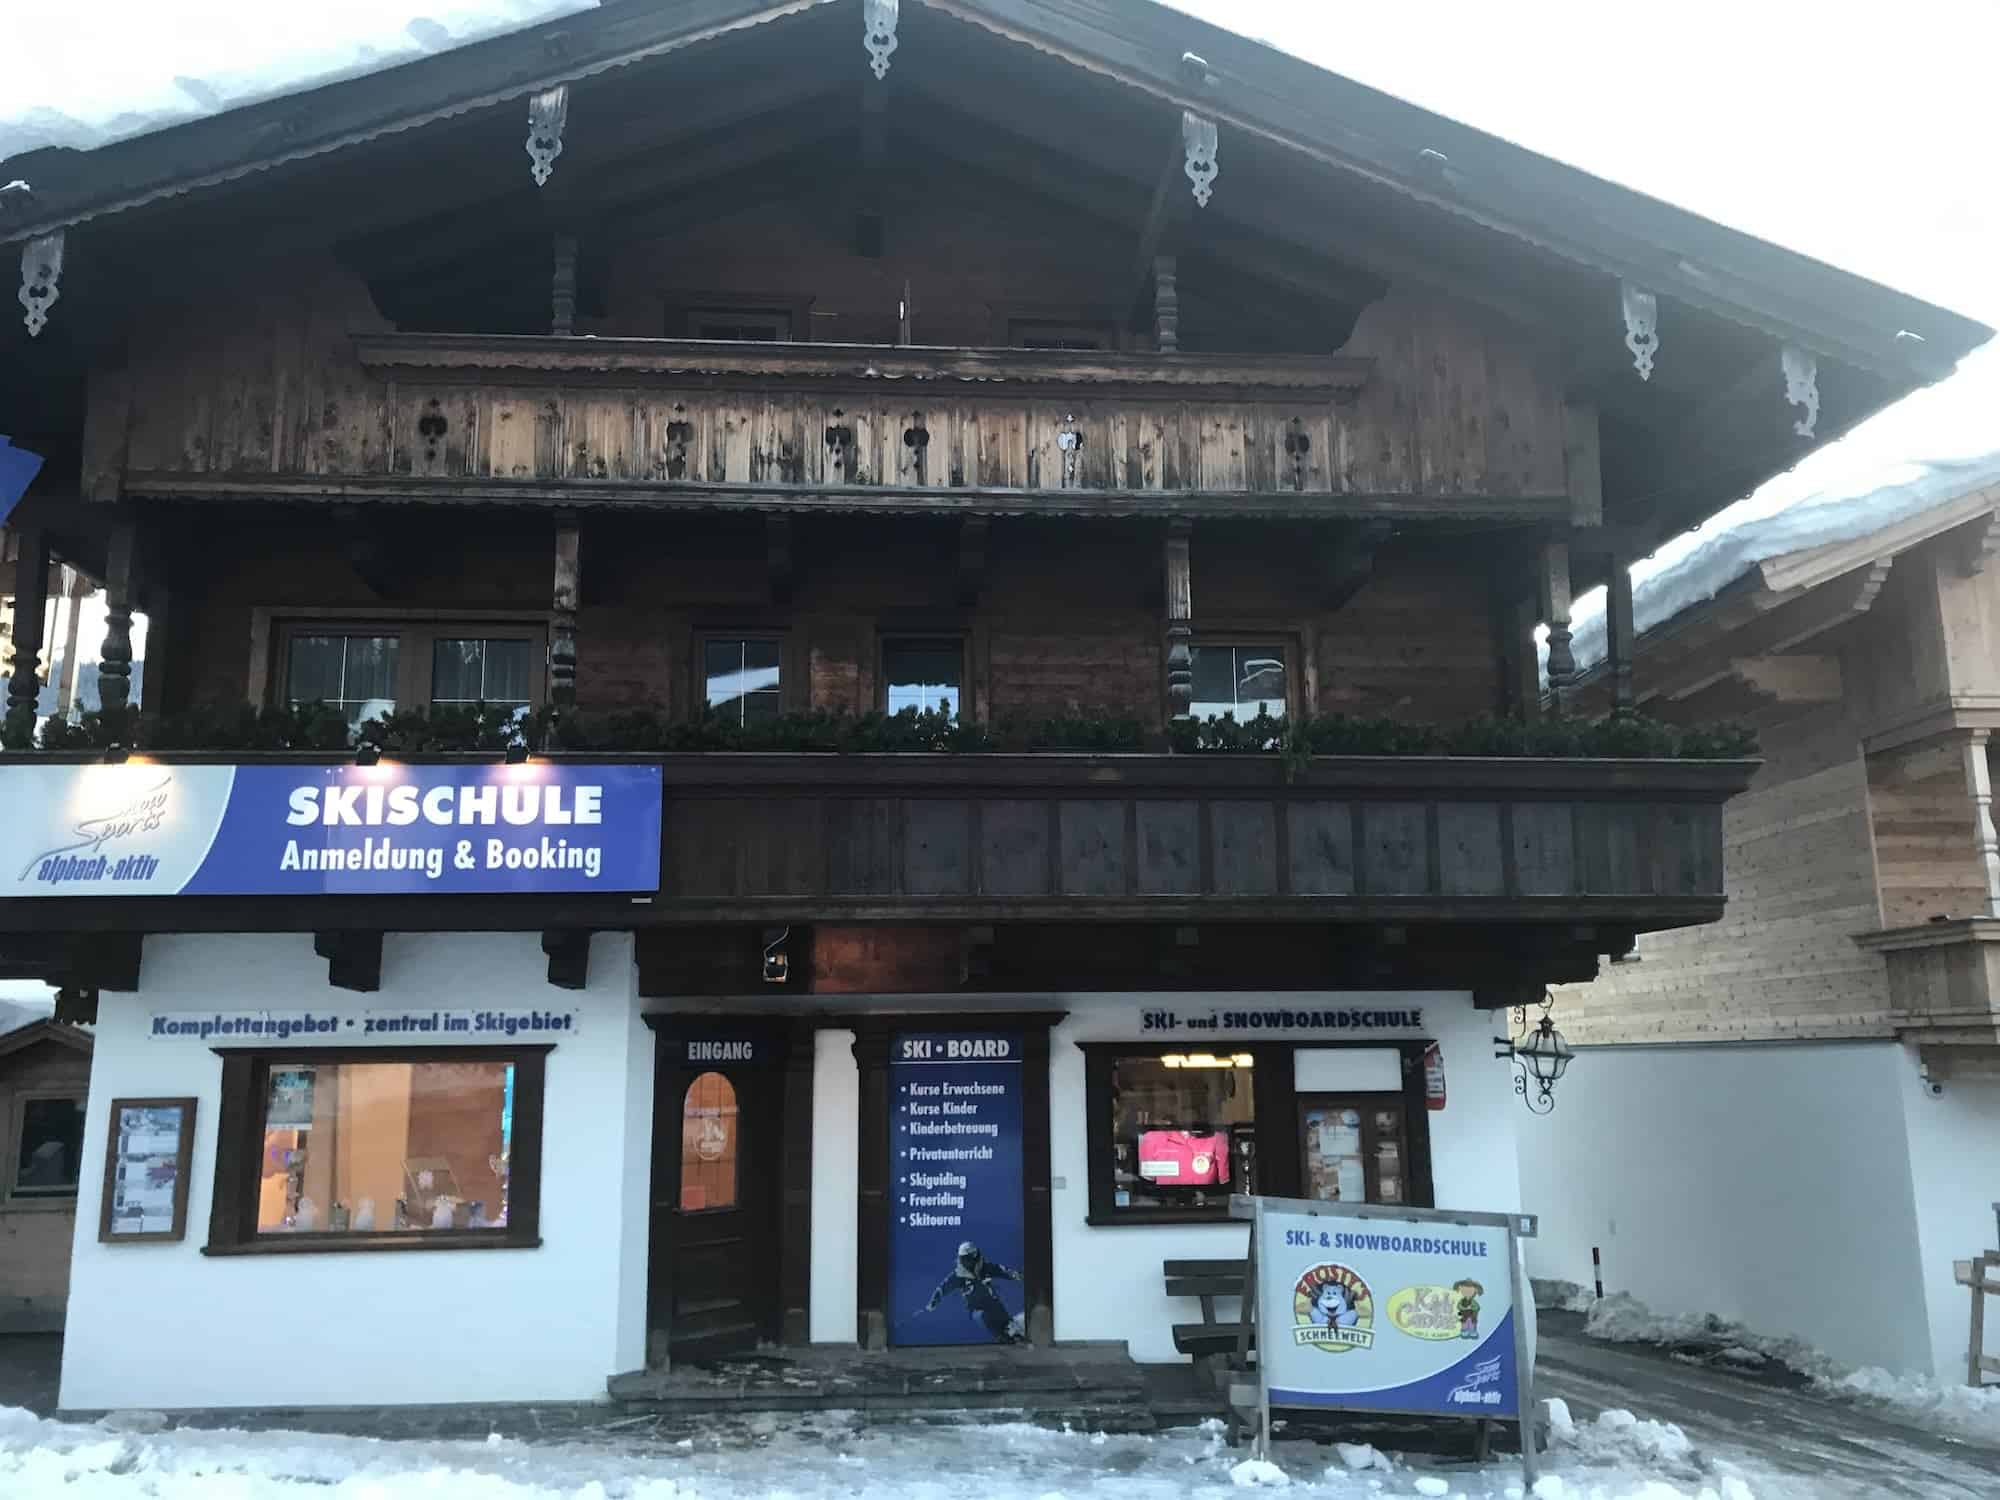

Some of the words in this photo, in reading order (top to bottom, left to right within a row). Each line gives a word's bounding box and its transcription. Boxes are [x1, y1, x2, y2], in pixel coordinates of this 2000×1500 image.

[286, 785, 603, 826] SKISCHULE
[280, 838, 443, 879] Anmeldung
[454, 839, 475, 870] &
[486, 837, 601, 878] Booking
[152, 1013, 338, 1040] Komplettangebot
[364, 1012, 439, 1032] zentral
[444, 1013, 469, 1031] im
[474, 1011, 572, 1036] Skigebiet
[1143, 1013, 1182, 1029] SKI-
[1187, 1014, 1218, 1029] und
[1224, 1010, 1421, 1029] SNOWBOARDSCHULE
[688, 1041, 753, 1060] EINGANG
[903, 1040, 931, 1058] SKI
[947, 1039, 1010, 1058] BOARD
[910, 1082, 940, 1096] Kurse
[943, 1081, 1005, 1095] Erwachsene
[910, 1101, 940, 1115] Kurse
[943, 1100, 978, 1114] Kinder
[910, 1120, 998, 1137] Kinderbetreuung
[910, 1145, 993, 1160] Privatunterricht
[910, 1171, 967, 1189] Skiguiding
[910, 1192, 964, 1208] Freeriding
[910, 1212, 961, 1226] Skitouren
[1286, 1230, 1315, 1246] SKI-
[1319, 1231, 1331, 1248] &
[1335, 1232, 1488, 1257] SNOWBOARDSCHULE
